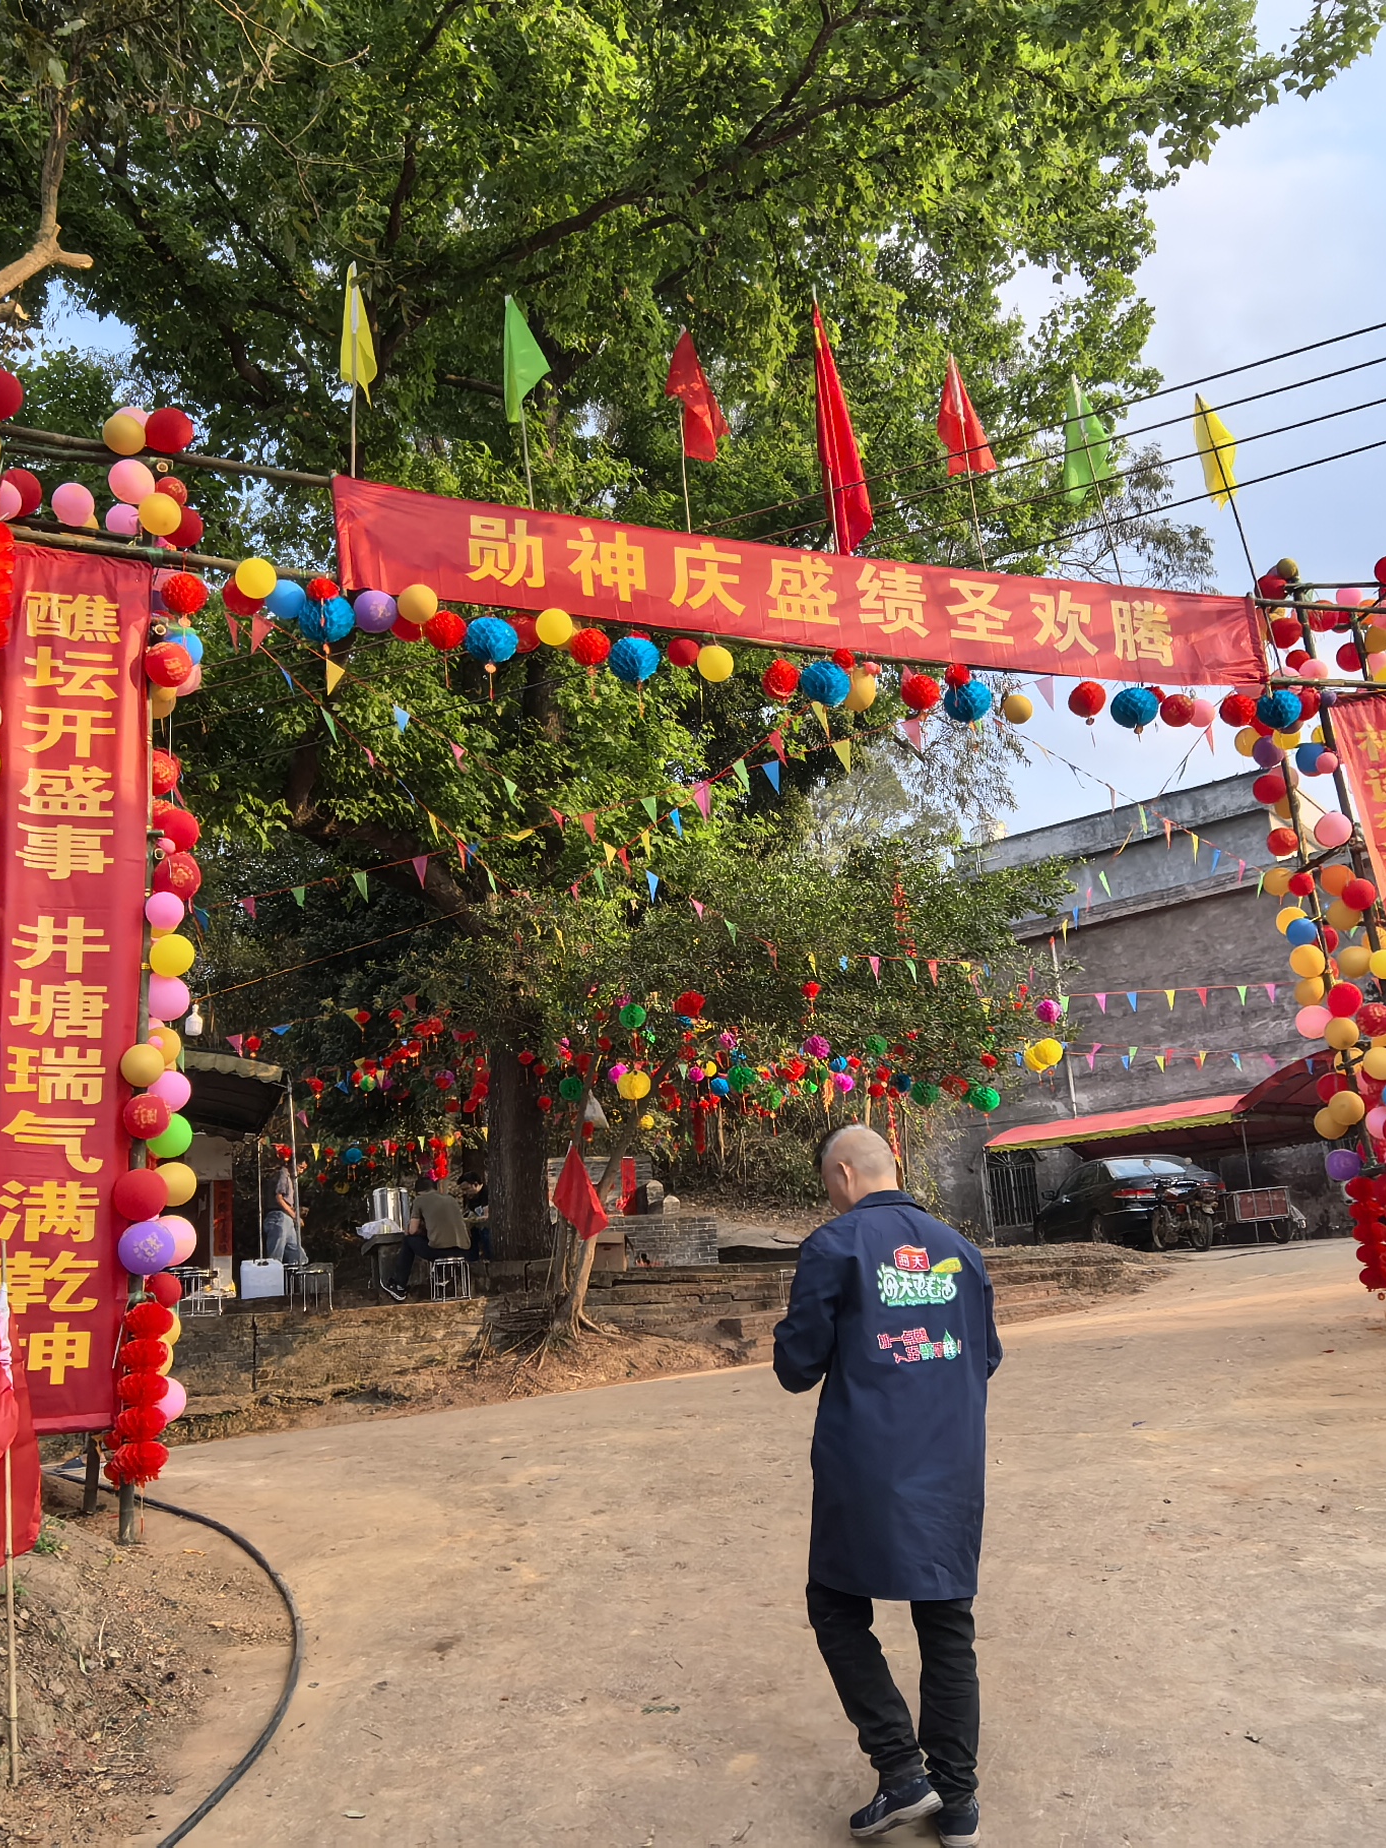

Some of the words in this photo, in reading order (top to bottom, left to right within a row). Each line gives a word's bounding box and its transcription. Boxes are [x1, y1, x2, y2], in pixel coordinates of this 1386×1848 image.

[466, 513, 1175, 668] 勋神庆盛绩圣欢腾
[15, 590, 122, 880] 醮坛开盛事
